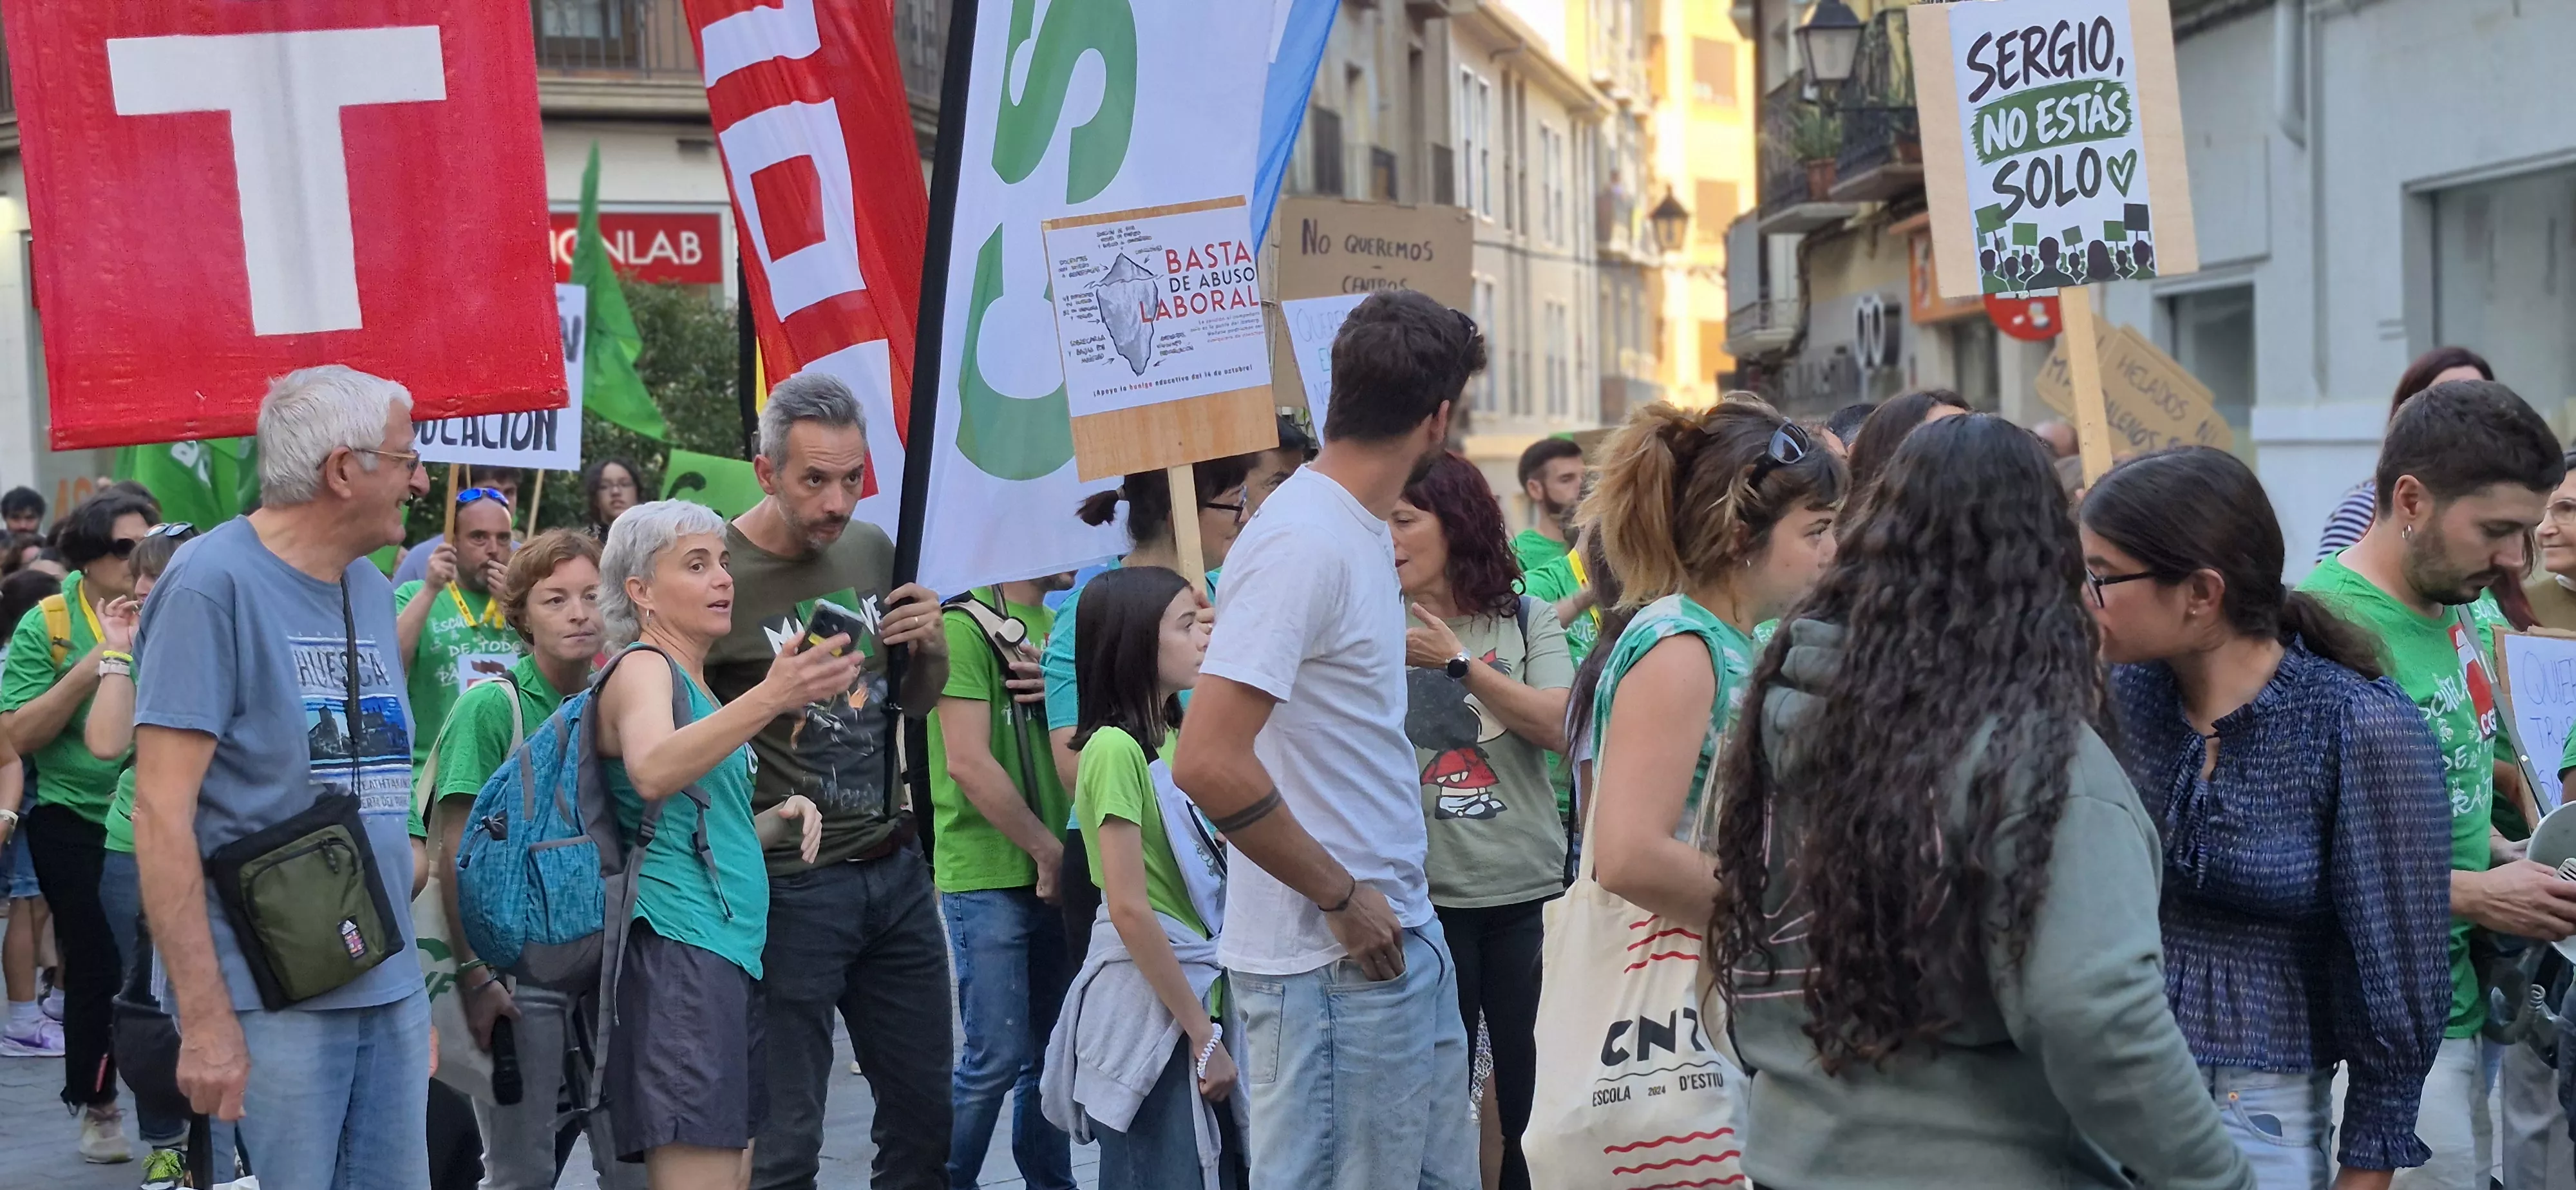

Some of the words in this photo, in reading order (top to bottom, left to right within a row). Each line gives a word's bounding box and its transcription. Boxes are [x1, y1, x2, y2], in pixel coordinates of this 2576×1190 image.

[1967, 15, 2124, 103] SERGIO,
[1982, 108, 2028, 155] NO
[2036, 82, 2126, 144] ESTÁS
[1992, 147, 2102, 222] SOLO
[1165, 240, 1251, 274] BASTA
[1344, 234, 1434, 261] QUEREMOS
[1170, 275, 1191, 293] DE
[1200, 267, 1255, 289] ABUSO
[1140, 285, 1260, 323] LABORAL
[1593, 1086, 1631, 1107] ESCOLA
[1648, 1085, 1666, 1097] 2024
[1679, 1072, 1723, 1091] D'ESTIU
